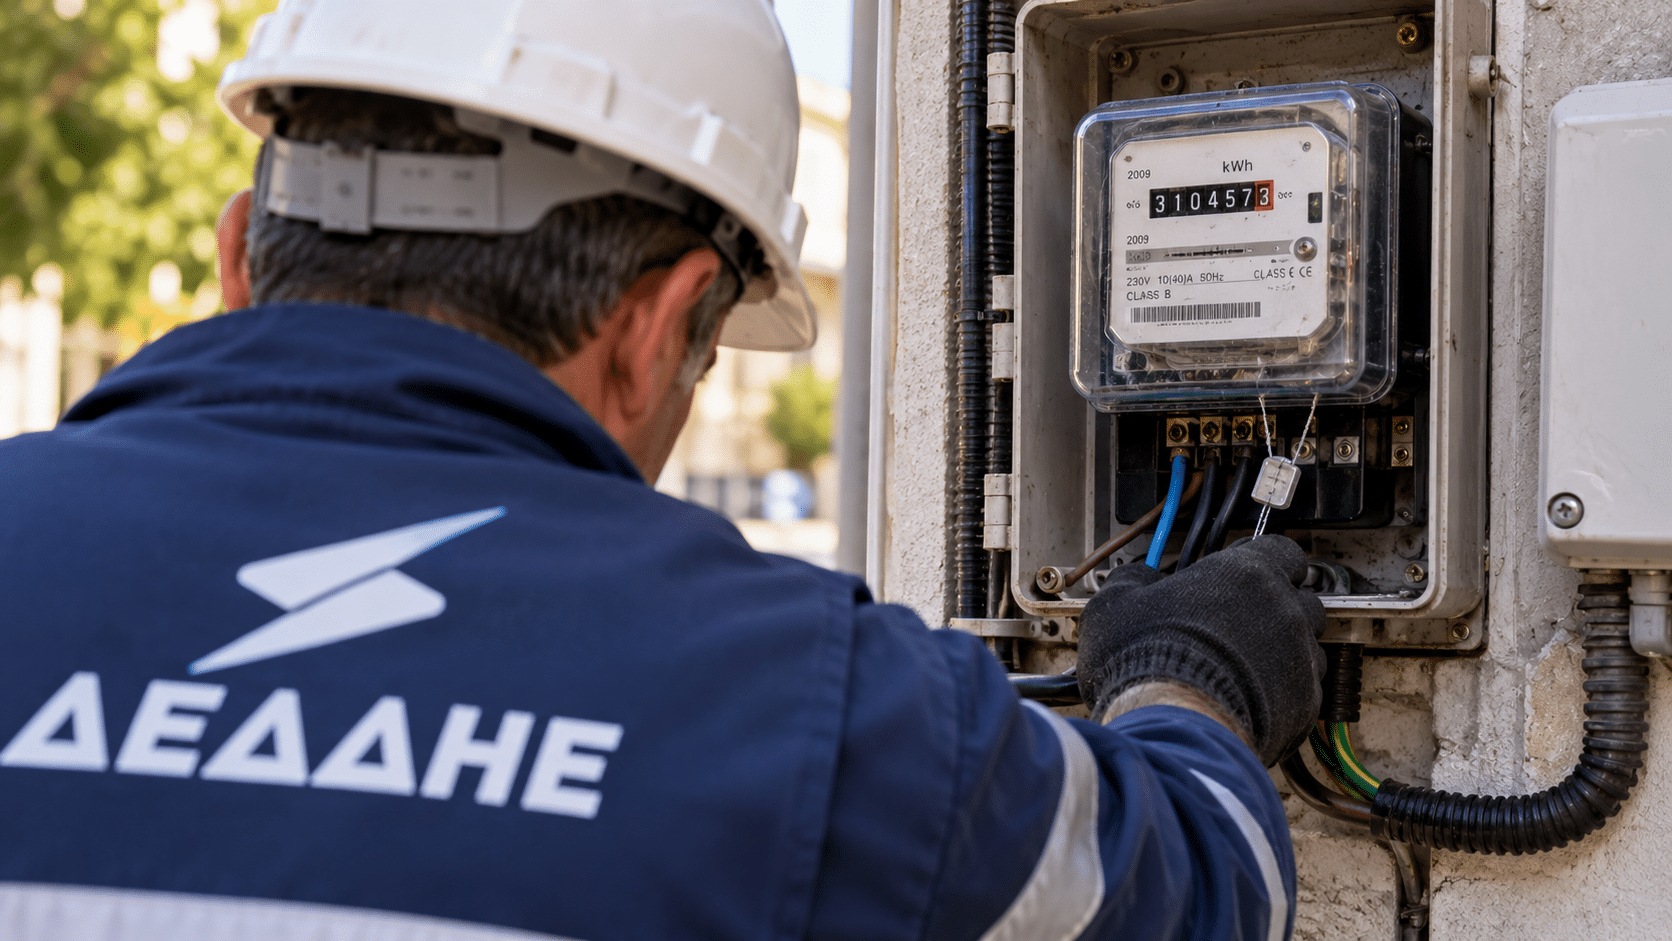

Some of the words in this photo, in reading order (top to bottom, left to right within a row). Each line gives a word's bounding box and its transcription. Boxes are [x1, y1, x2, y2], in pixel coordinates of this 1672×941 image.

[1222, 159, 1253, 173] kWh
[1127, 169, 1151, 180] 2009
[1155, 187, 1269, 213] 3104573
[1126, 234, 1149, 245] 2009
[1253, 267, 1286, 280] CLASS
[1126, 276, 1151, 287] 230V
[1126, 289, 1160, 301] CLASS
[1164, 288, 1172, 299] B
[0, 671, 624, 819] ΔΕΔΔΗΕ
